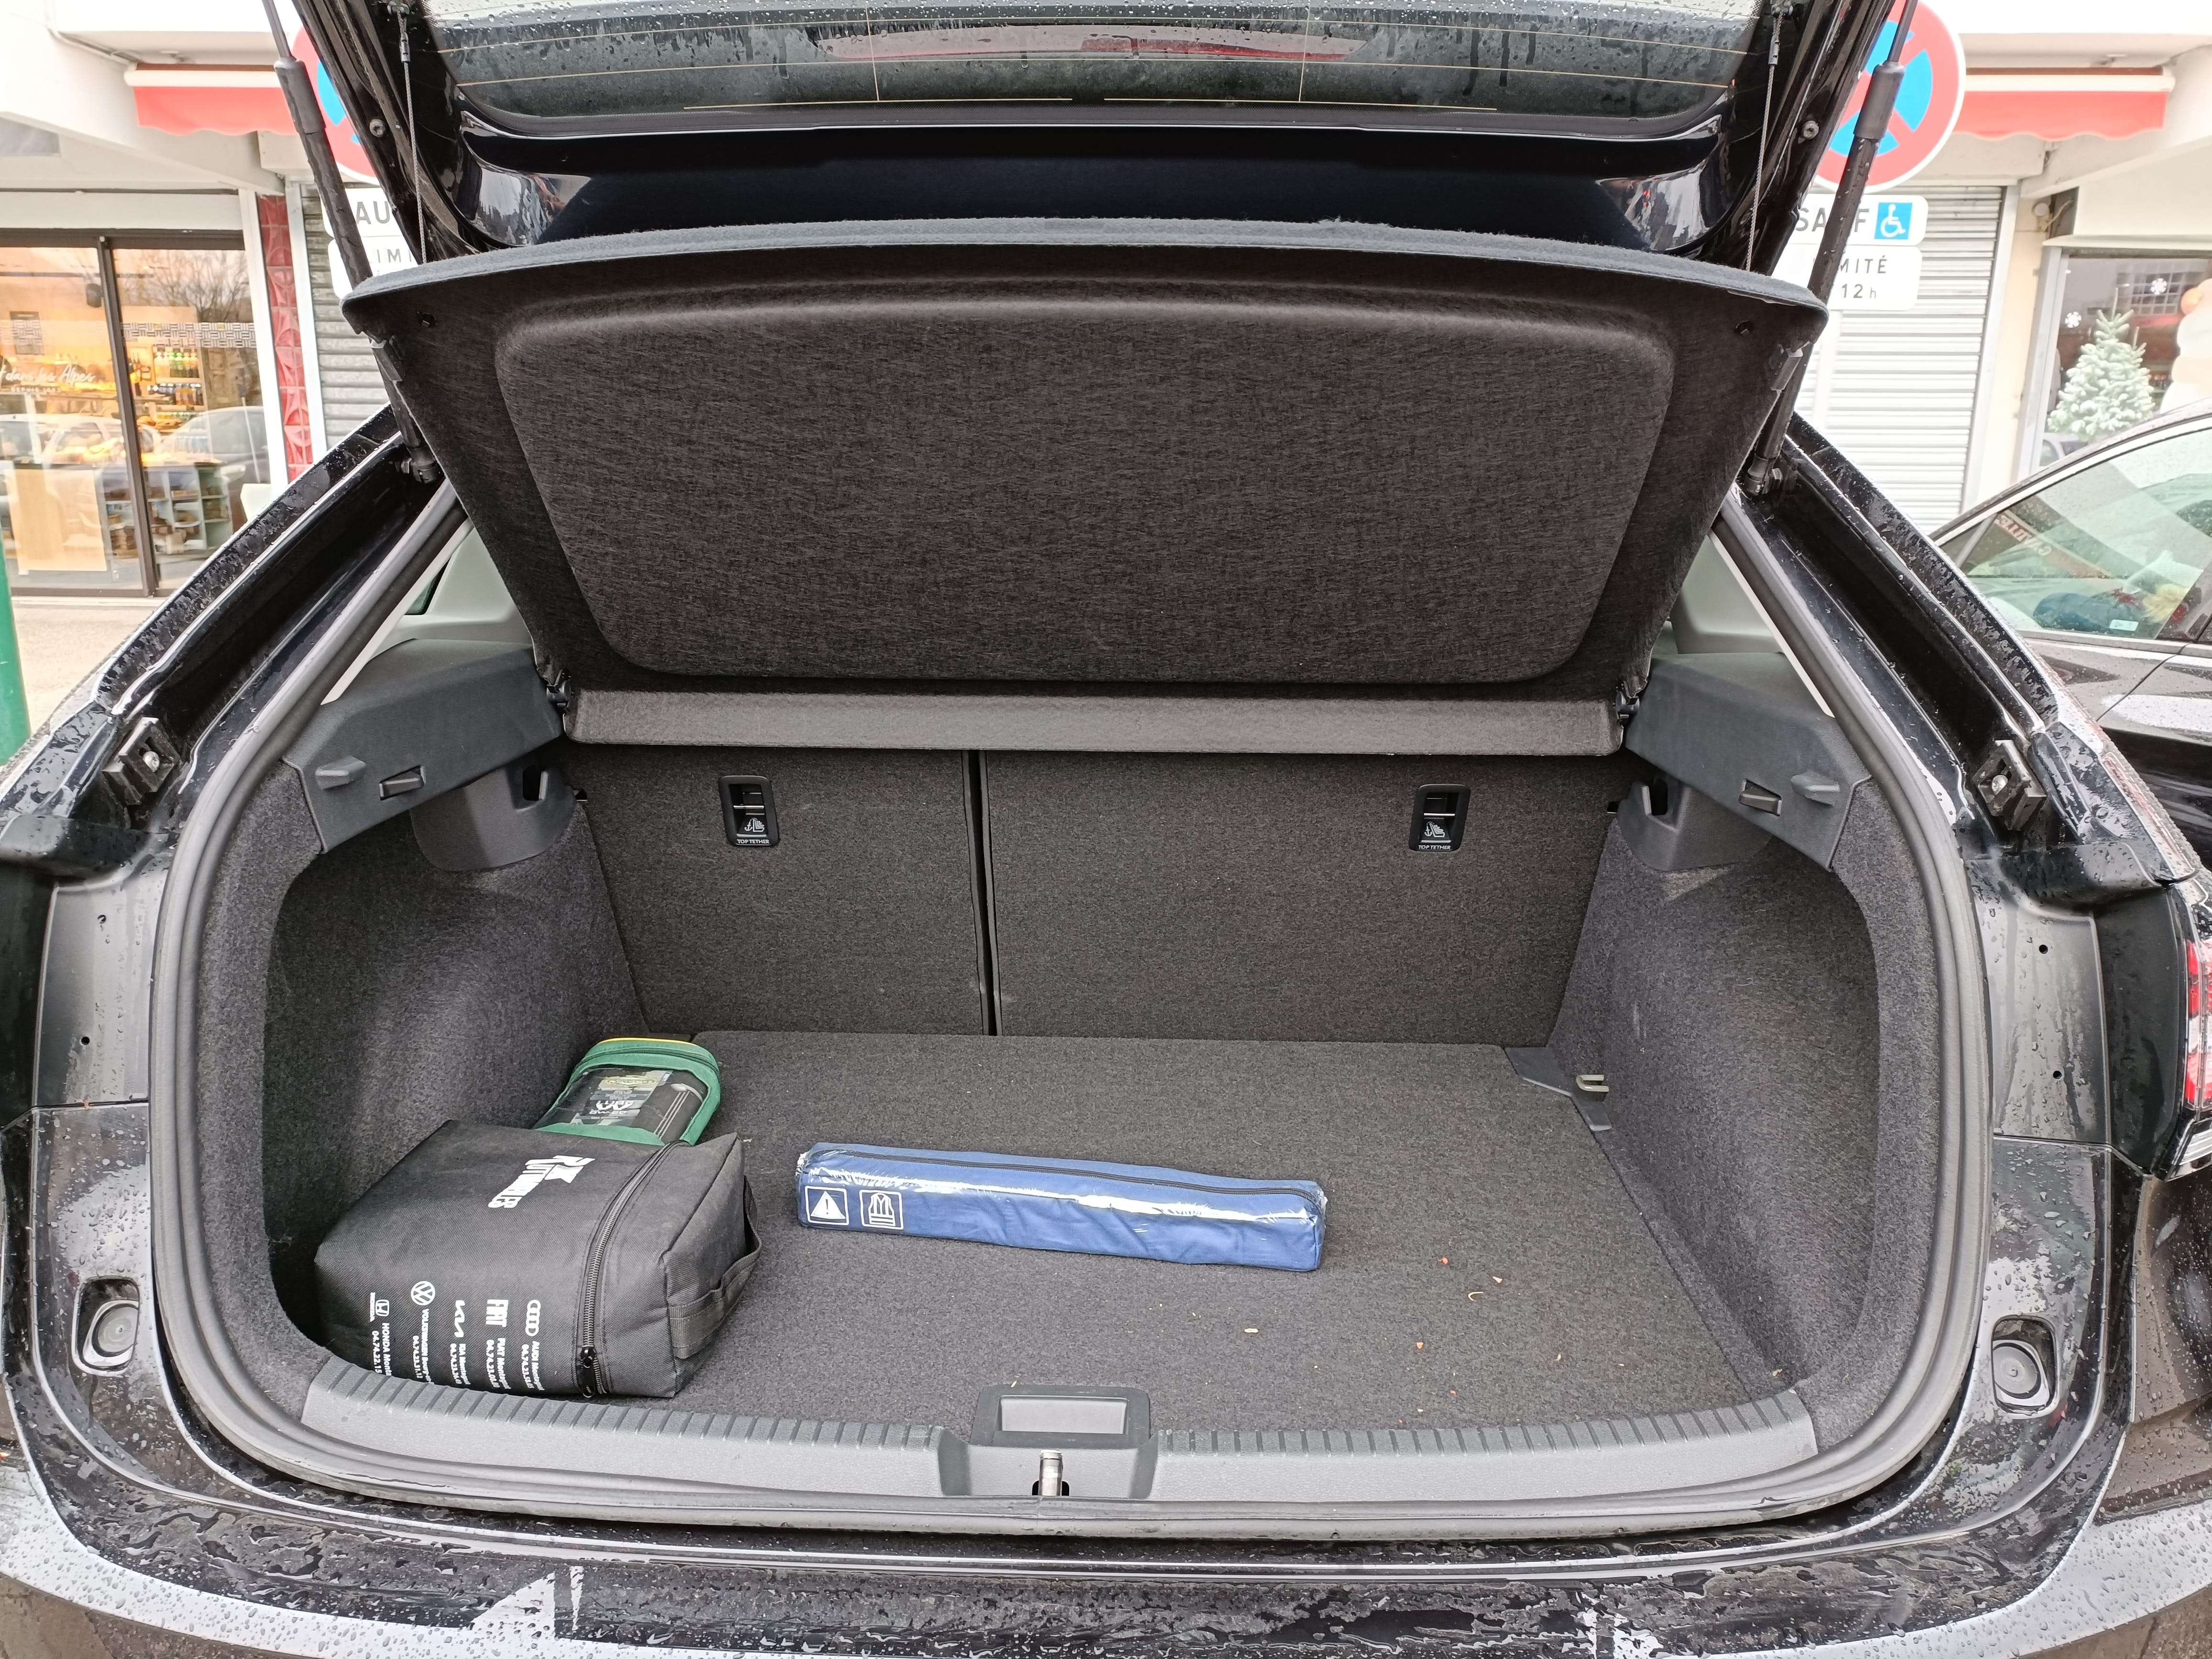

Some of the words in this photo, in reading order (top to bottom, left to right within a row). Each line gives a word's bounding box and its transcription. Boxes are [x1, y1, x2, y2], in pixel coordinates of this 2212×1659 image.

[356, 201, 391, 225] AU
[1795, 207, 1870, 232] SAF
[486, 1299, 509, 1327] FIAT
[382, 1323, 390, 1352] HONDA
[421, 1308, 429, 1356] VOLKSWAGEN
[372, 1330, 383, 1374] 04.74.22.15
[497, 1338, 506, 1357] FIAT
[531, 1340, 540, 1361] AUDI
[383, 1354, 392, 1376] Monta
[497, 1357, 511, 1389] Montagnat
[531, 1362, 545, 1391] Montagnat
